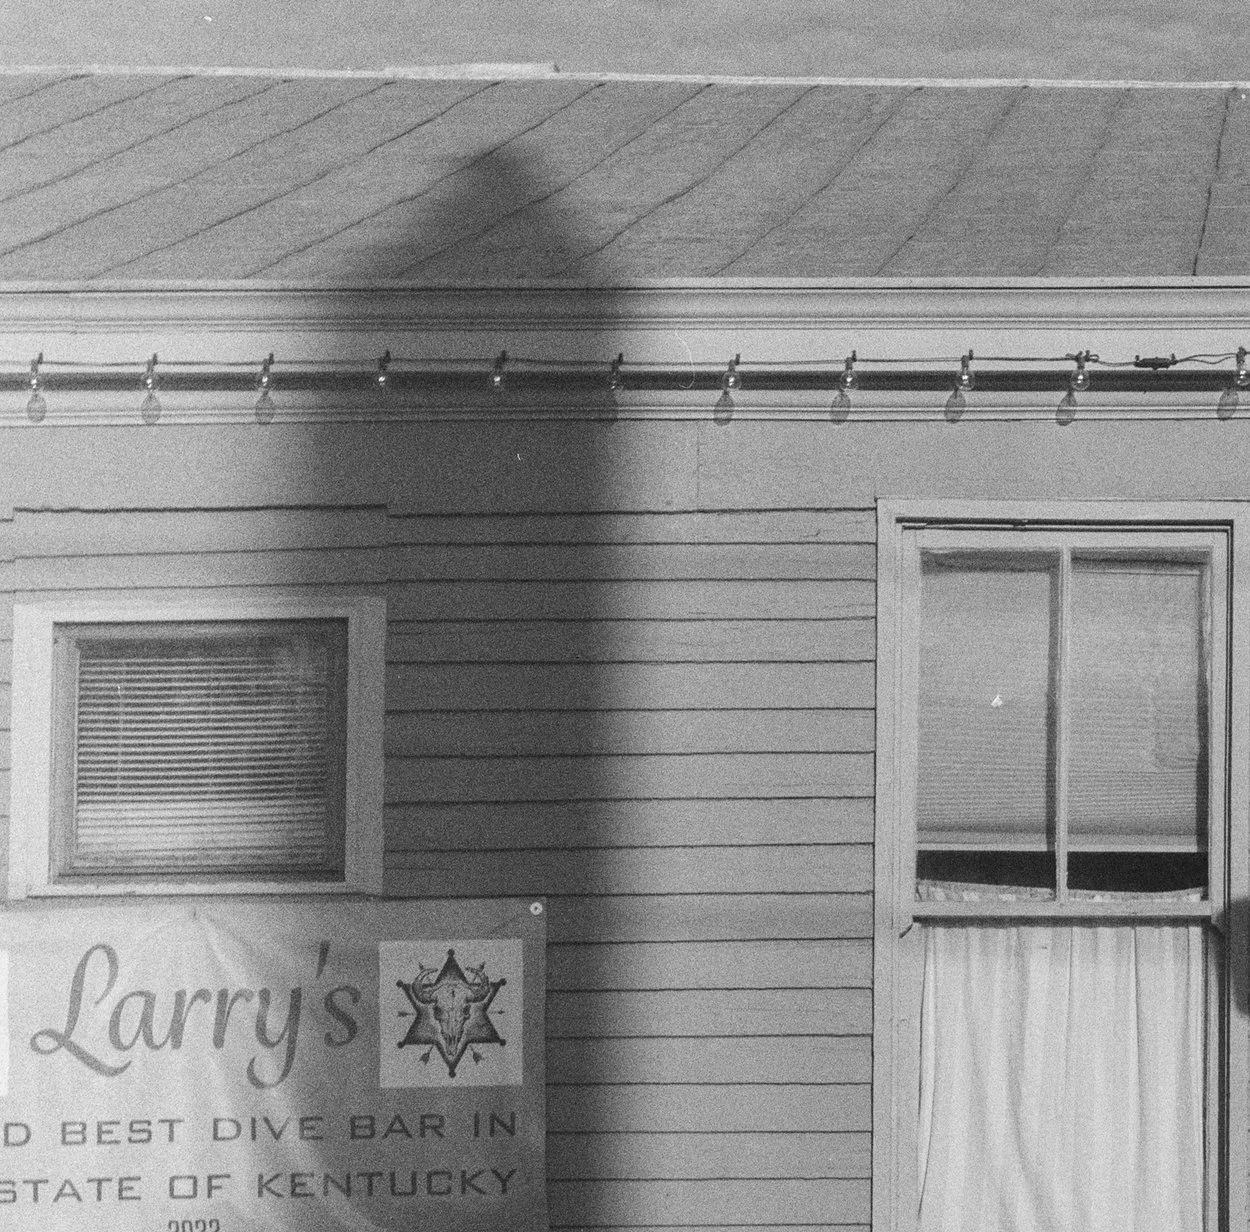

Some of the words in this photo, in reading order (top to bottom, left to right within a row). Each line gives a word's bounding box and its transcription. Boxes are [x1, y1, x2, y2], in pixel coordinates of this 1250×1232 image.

[29, 939, 362, 1090] Larry's
[60, 1117, 186, 1146] BEST
[212, 1115, 324, 1142] DIVE
[350, 1112, 447, 1140] BAR
[472, 1110, 517, 1138] IN
[0, 1174, 143, 1204] STATE
[168, 1172, 232, 1200] OF
[256, 1167, 517, 1199] KENTUCKY
